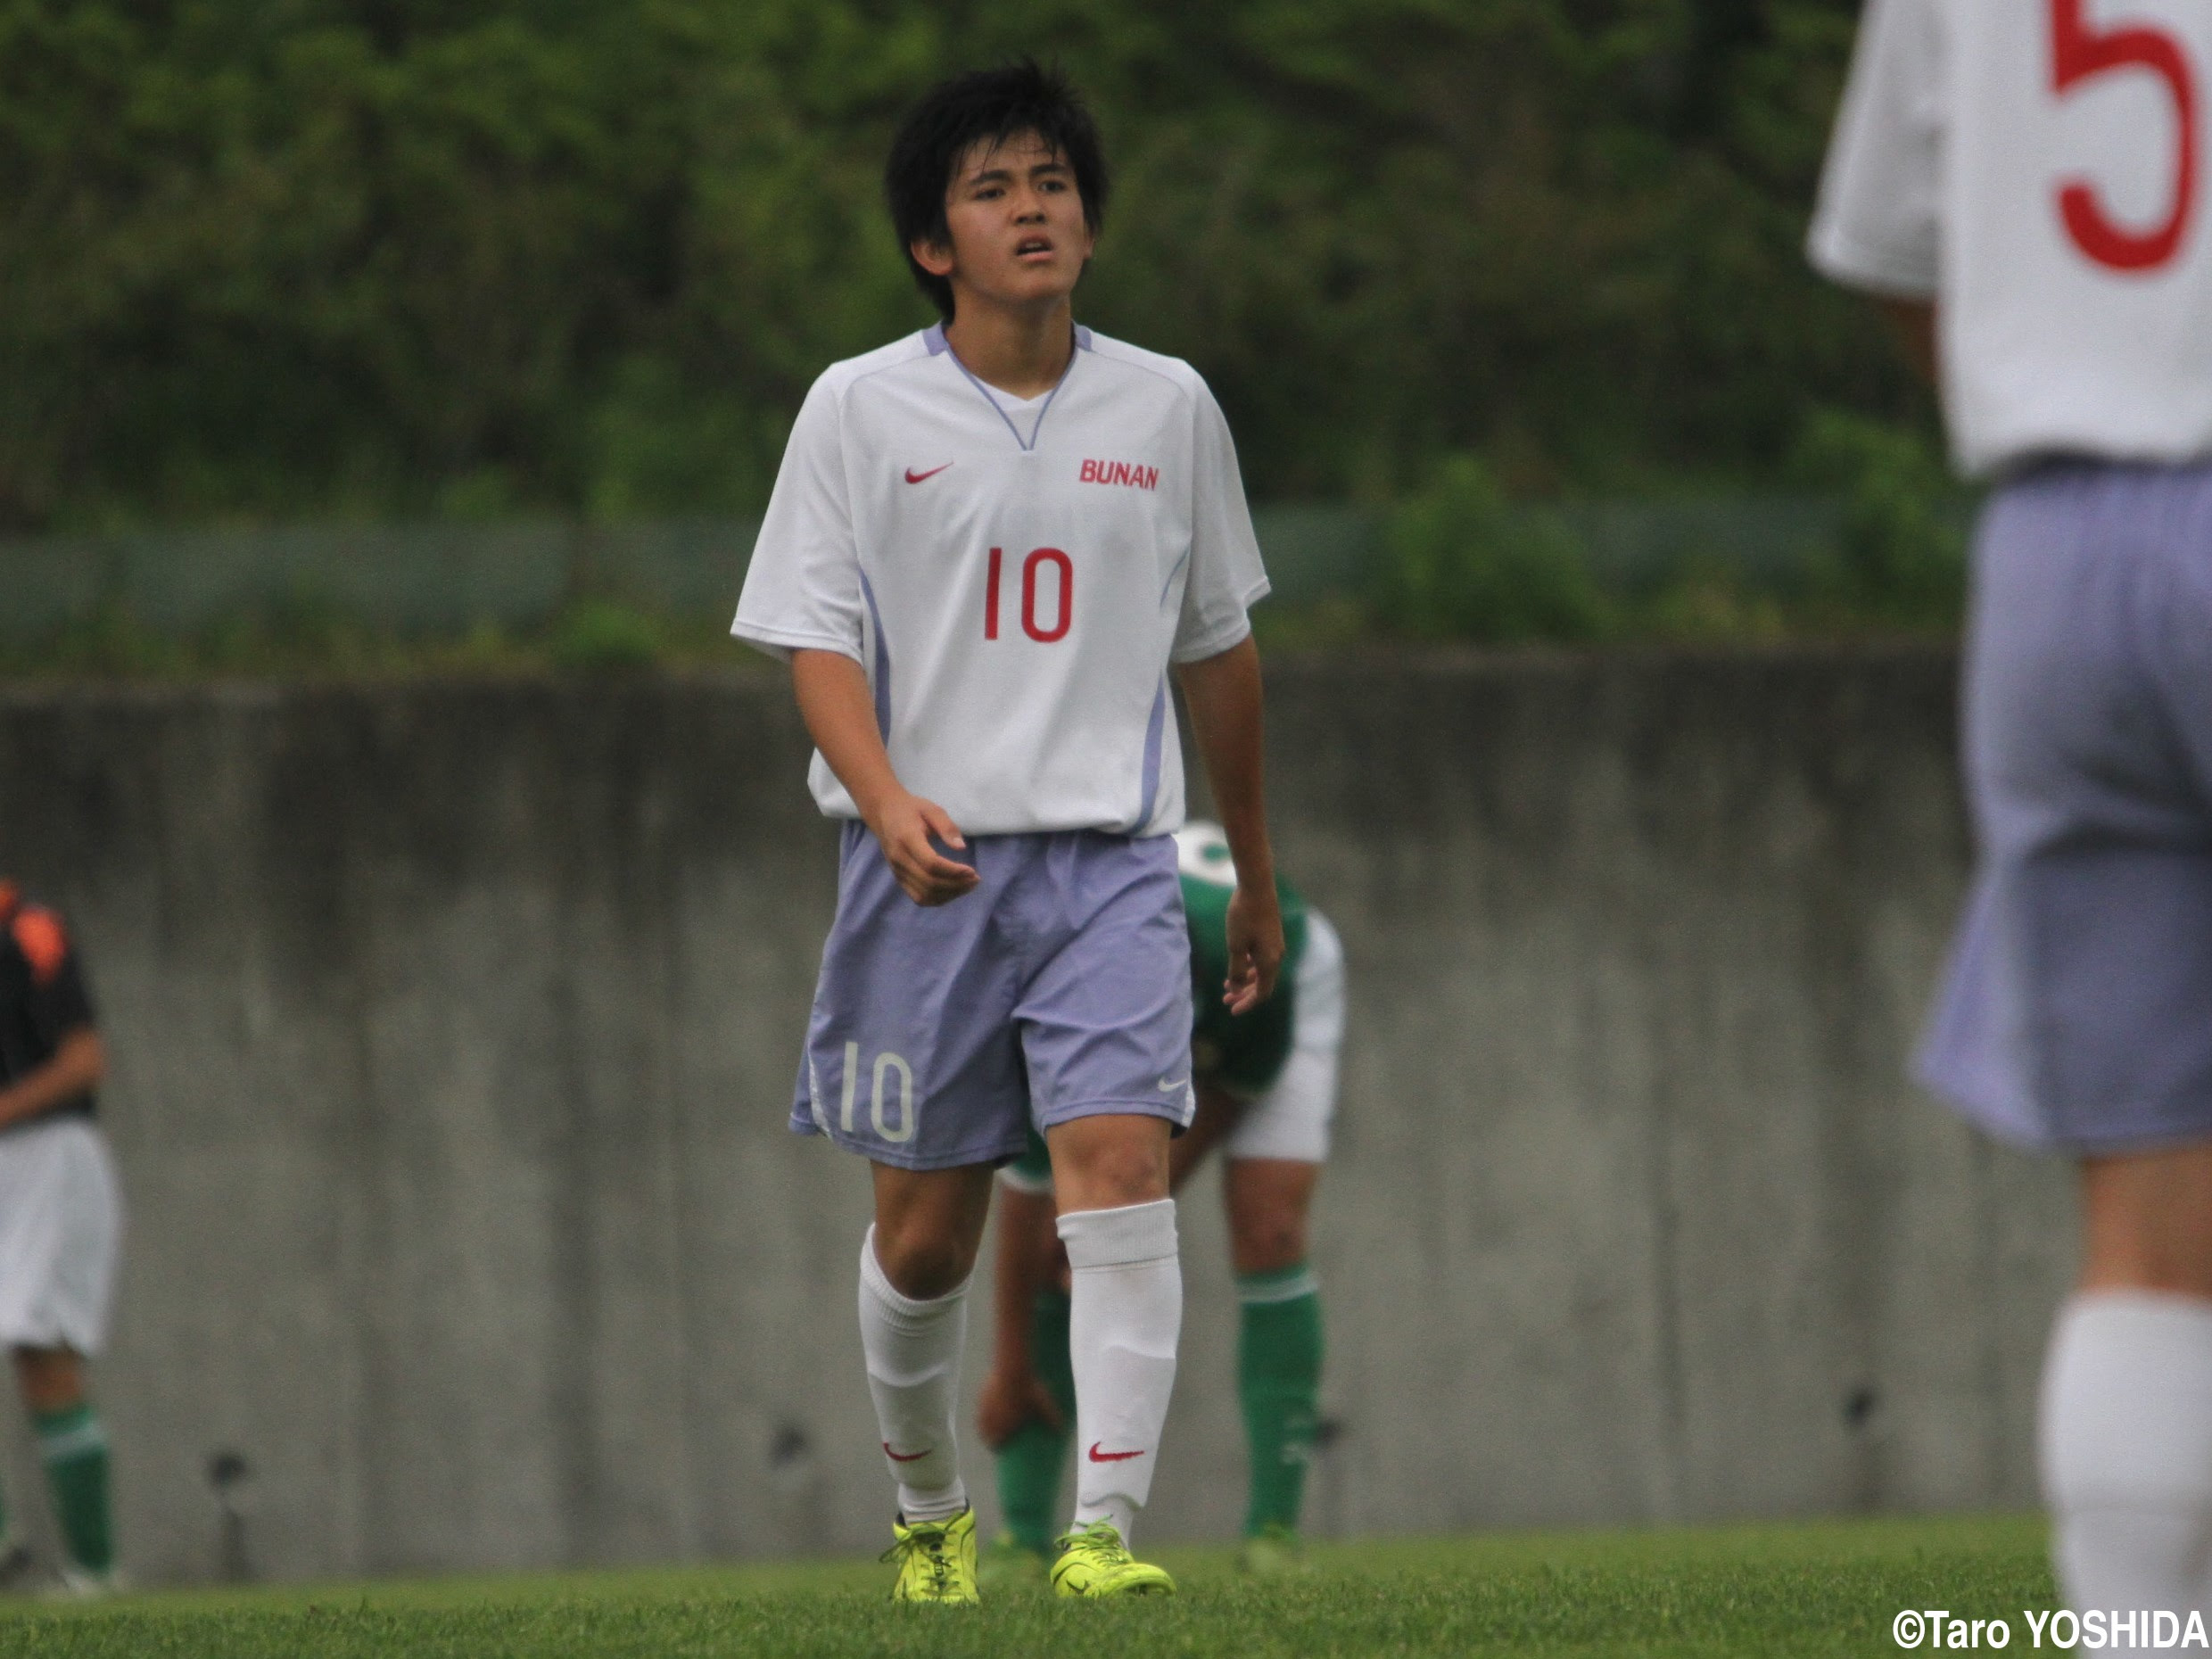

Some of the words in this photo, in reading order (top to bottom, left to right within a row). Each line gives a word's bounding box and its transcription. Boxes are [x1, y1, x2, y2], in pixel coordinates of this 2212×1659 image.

[2049, 0, 2197, 272] 5
[1079, 458, 1159, 491] BUNAN
[985, 547, 1073, 643] 10
[840, 1041, 913, 1143] 10
